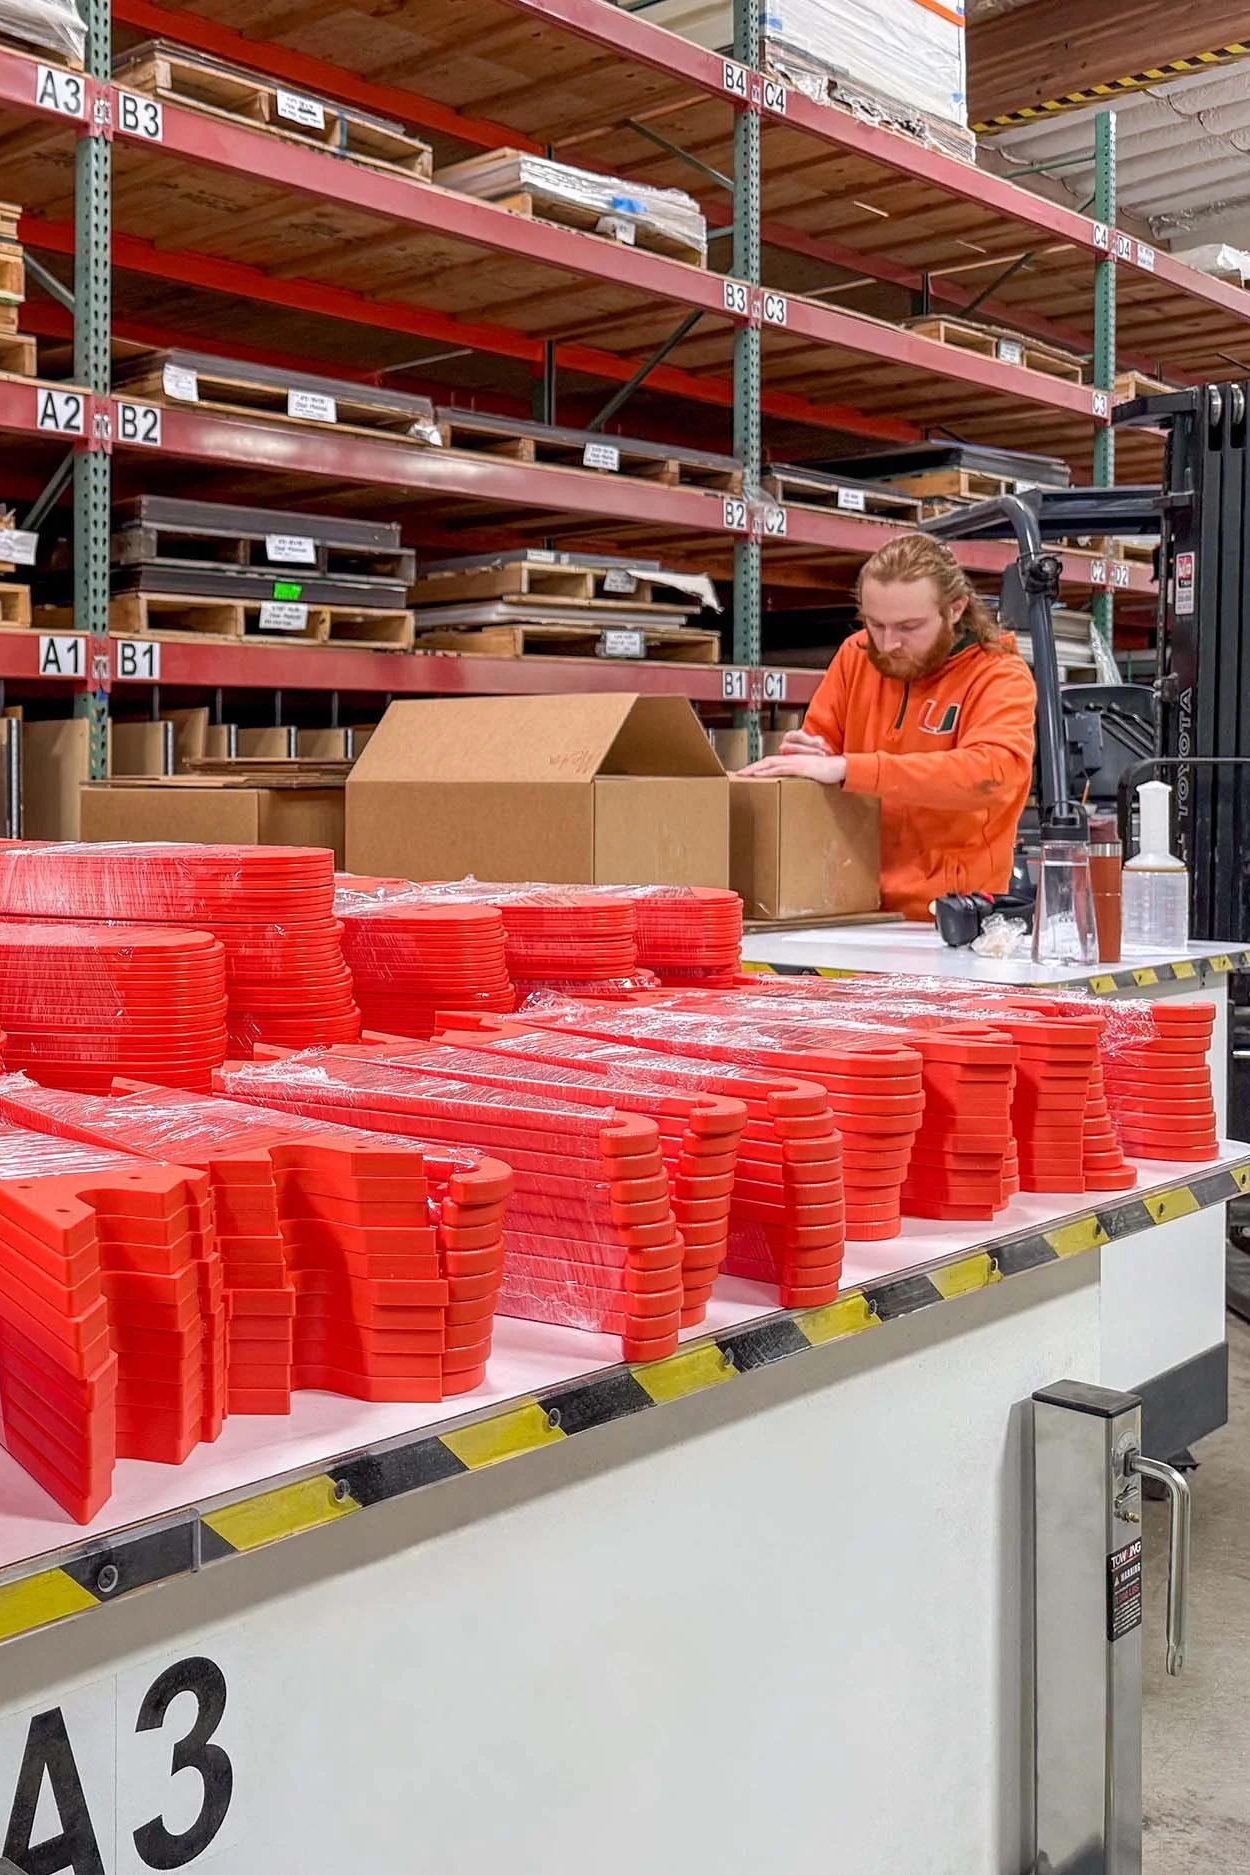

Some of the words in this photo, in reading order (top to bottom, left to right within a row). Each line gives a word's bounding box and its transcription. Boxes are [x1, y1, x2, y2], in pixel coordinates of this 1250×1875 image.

[38, 70, 82, 115] A3
[725, 63, 745, 95] B4
[764, 82, 785, 112] C4
[121, 94, 160, 138] B3
[1094, 225, 1107, 248] C4
[1118, 237, 1130, 257] D4
[725, 283, 746, 313] B3
[764, 294, 785, 324] C3
[39, 391, 81, 433] A2
[1093, 394, 1106, 416] C3
[121, 404, 159, 444] B2
[725, 502, 745, 528] B2
[765, 507, 785, 533] C2
[1091, 560, 1104, 582] C2
[1115, 566, 1128, 586] D2
[41, 637, 79, 675] A1
[120, 642, 154, 678] B1
[724, 672, 743, 698] B1
[764, 673, 784, 699] C1
[917, 699, 961, 735] U
[1177, 686, 1193, 822] TOYOTA
[1, 1656, 234, 1875] A3
